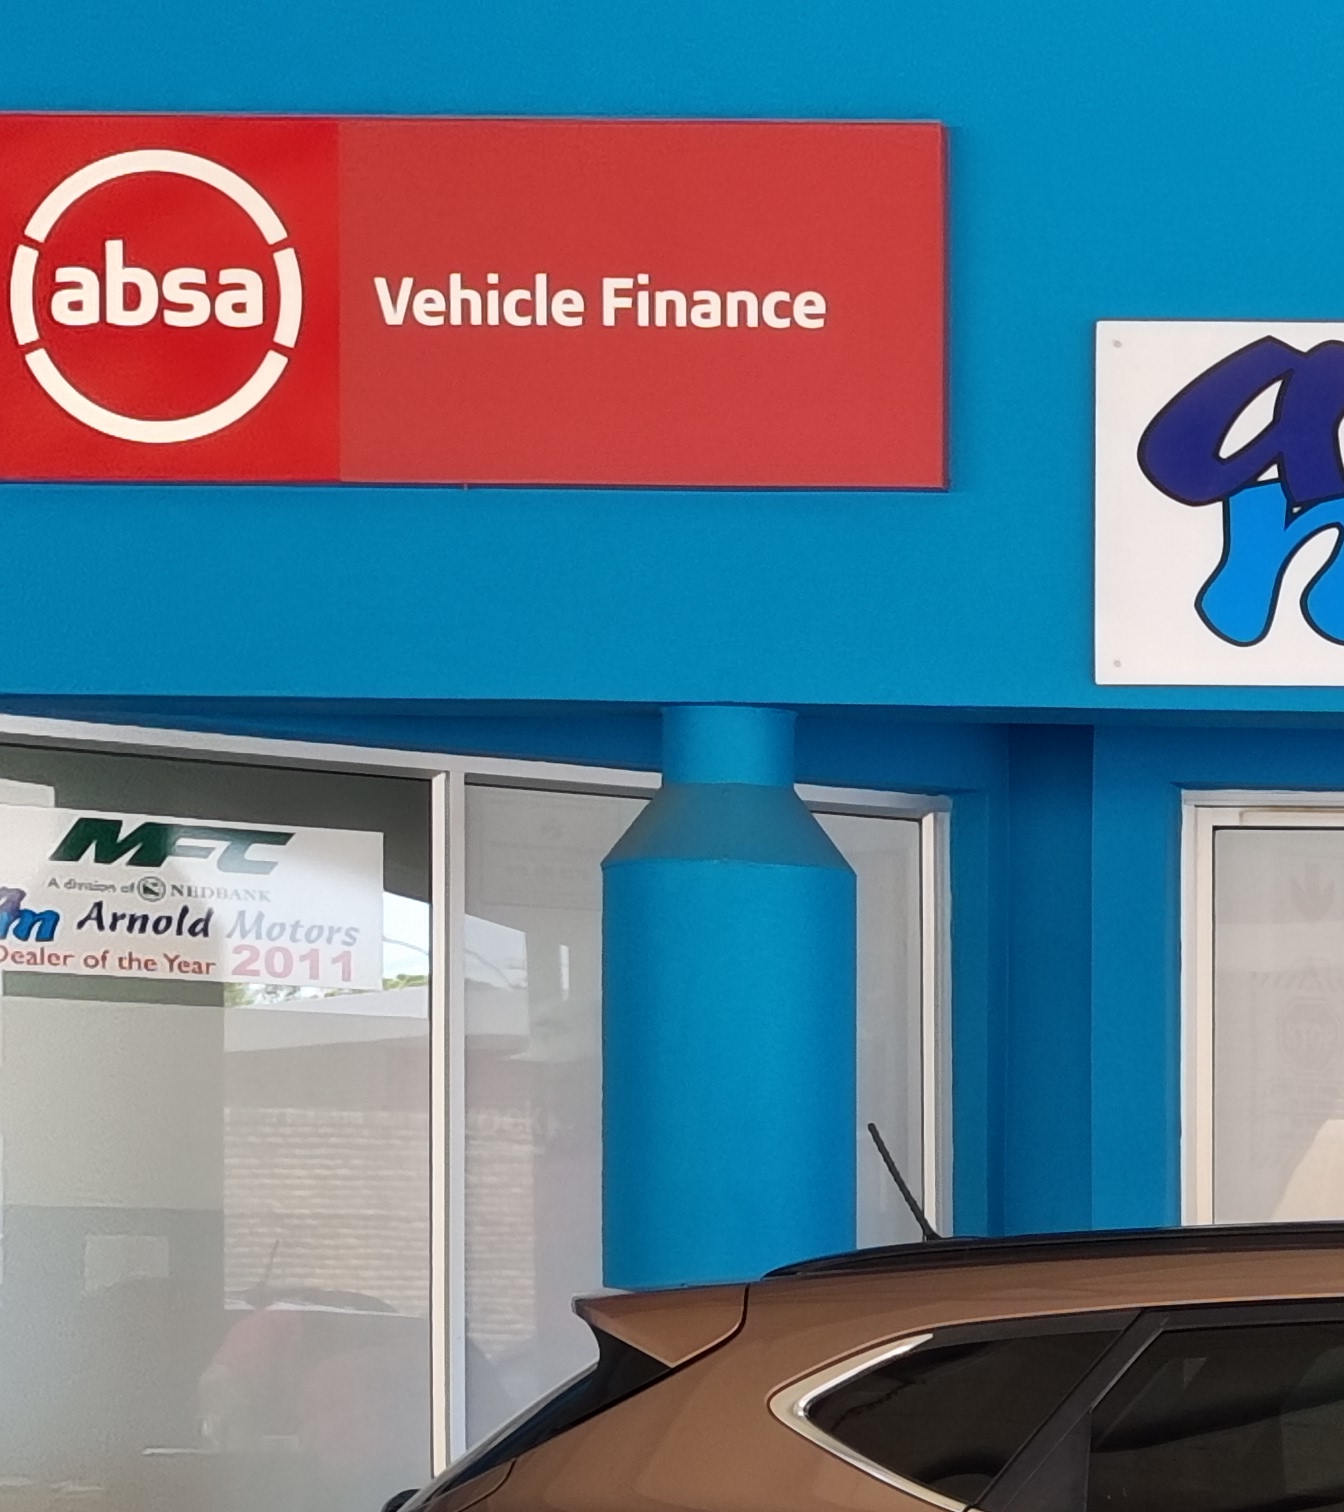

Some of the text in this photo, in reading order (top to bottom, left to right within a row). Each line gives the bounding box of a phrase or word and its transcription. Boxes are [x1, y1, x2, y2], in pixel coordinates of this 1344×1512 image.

[50, 238, 266, 328] absa
[373, 273, 828, 330] Vehicle Finance
[76, 900, 360, 946] Arnold Motors
[83, 949, 110, 969] of
[118, 951, 157, 971] the
[163, 952, 217, 976] Year
[231, 943, 352, 982] 2011
